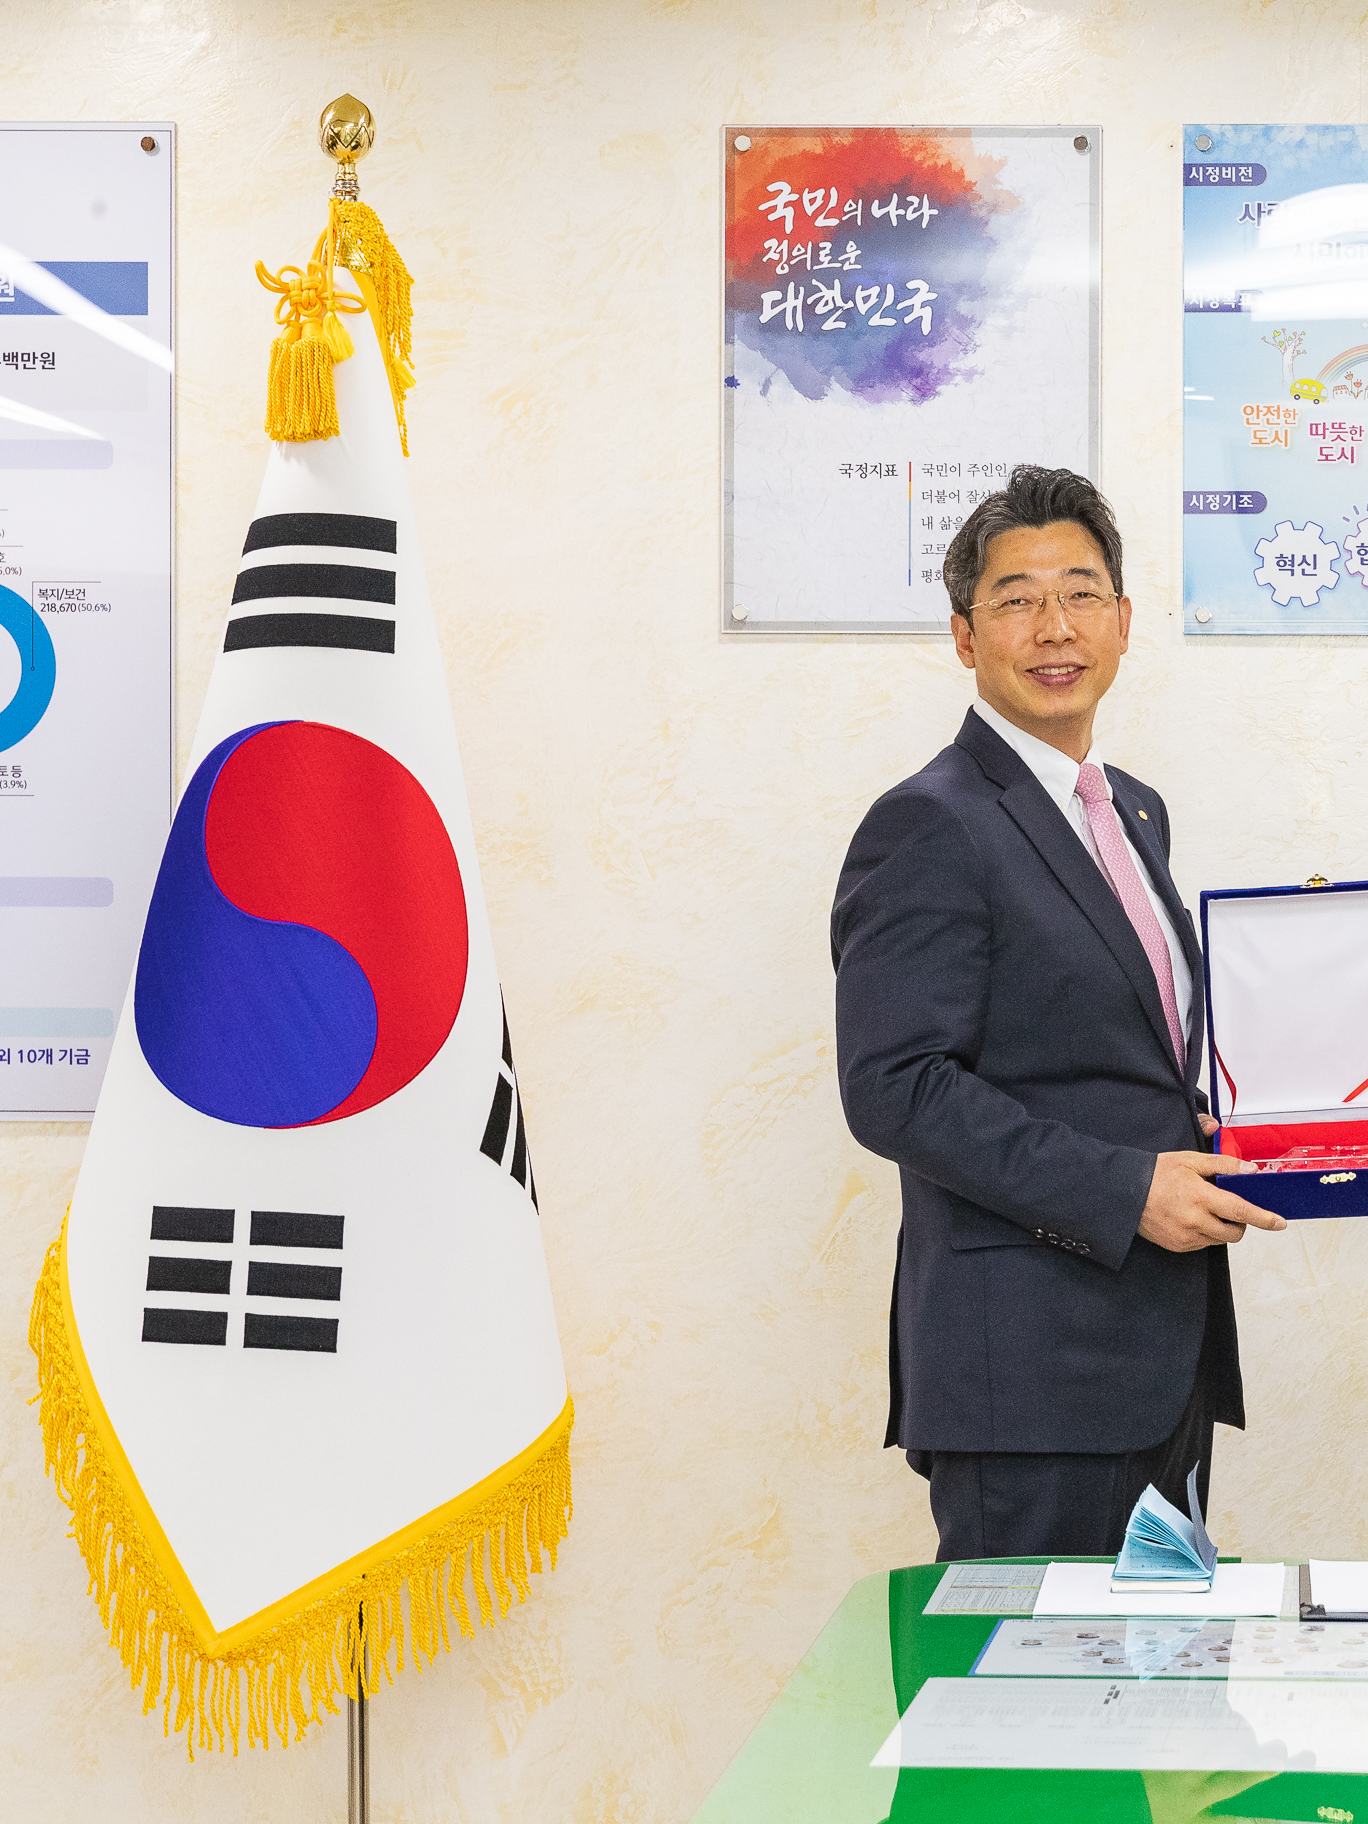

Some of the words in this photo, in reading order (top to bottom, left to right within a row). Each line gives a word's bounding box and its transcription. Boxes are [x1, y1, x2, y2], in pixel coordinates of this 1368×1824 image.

[1189, 165, 1254, 183] 시정비전
[758, 181, 863, 234] 국민의
[870, 192, 939, 229] 나라
[762, 238, 862, 274] 정의로운
[758, 278, 938, 335] 대한민국
[0, 351, 56, 371] 백만원
[1242, 404, 1299, 426] 안전한
[1250, 428, 1290, 448] 도시
[1309, 421, 1365, 443] 따뜻한
[1317, 446, 1356, 464] 도시
[838, 462, 899, 479] 국정지표
[921, 463, 961, 478] 국민이
[967, 463, 1007, 478] 주인인
[921, 489, 960, 504] 더불어
[1189, 494, 1254, 511] 시정기조
[921, 516, 933, 531] 내
[1274, 553, 1318, 577] 혁신
[38, 588, 86, 600] 복지/보건
[18, 1048, 53, 1065] 10개
[58, 1048, 91, 1065] 기금
